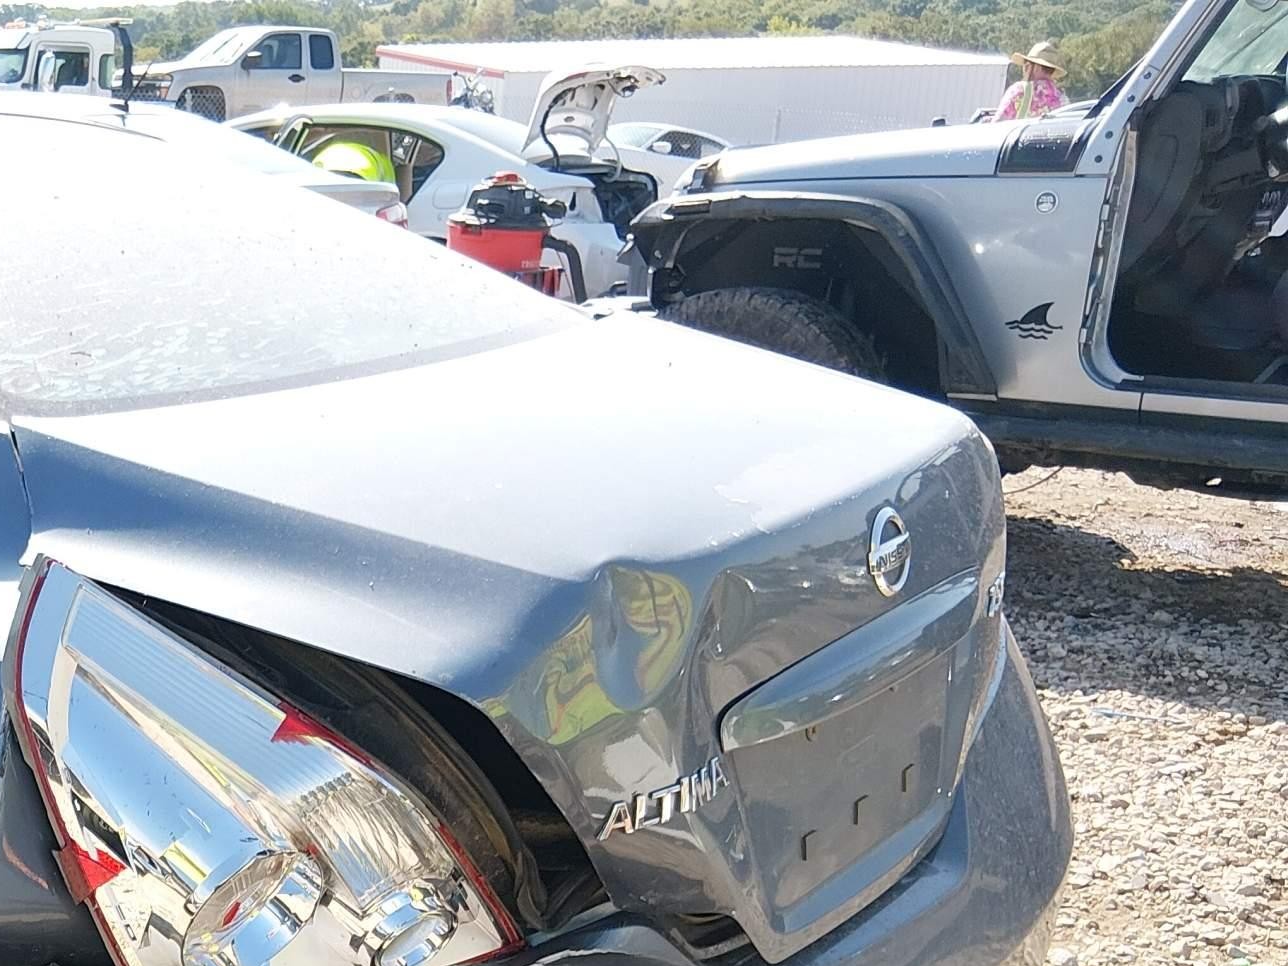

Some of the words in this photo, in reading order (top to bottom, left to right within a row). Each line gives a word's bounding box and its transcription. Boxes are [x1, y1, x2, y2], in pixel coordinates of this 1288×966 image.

[774, 247, 823, 269] RC
[875, 541, 908, 573] NISS
[596, 756, 730, 841] ALTIMA
